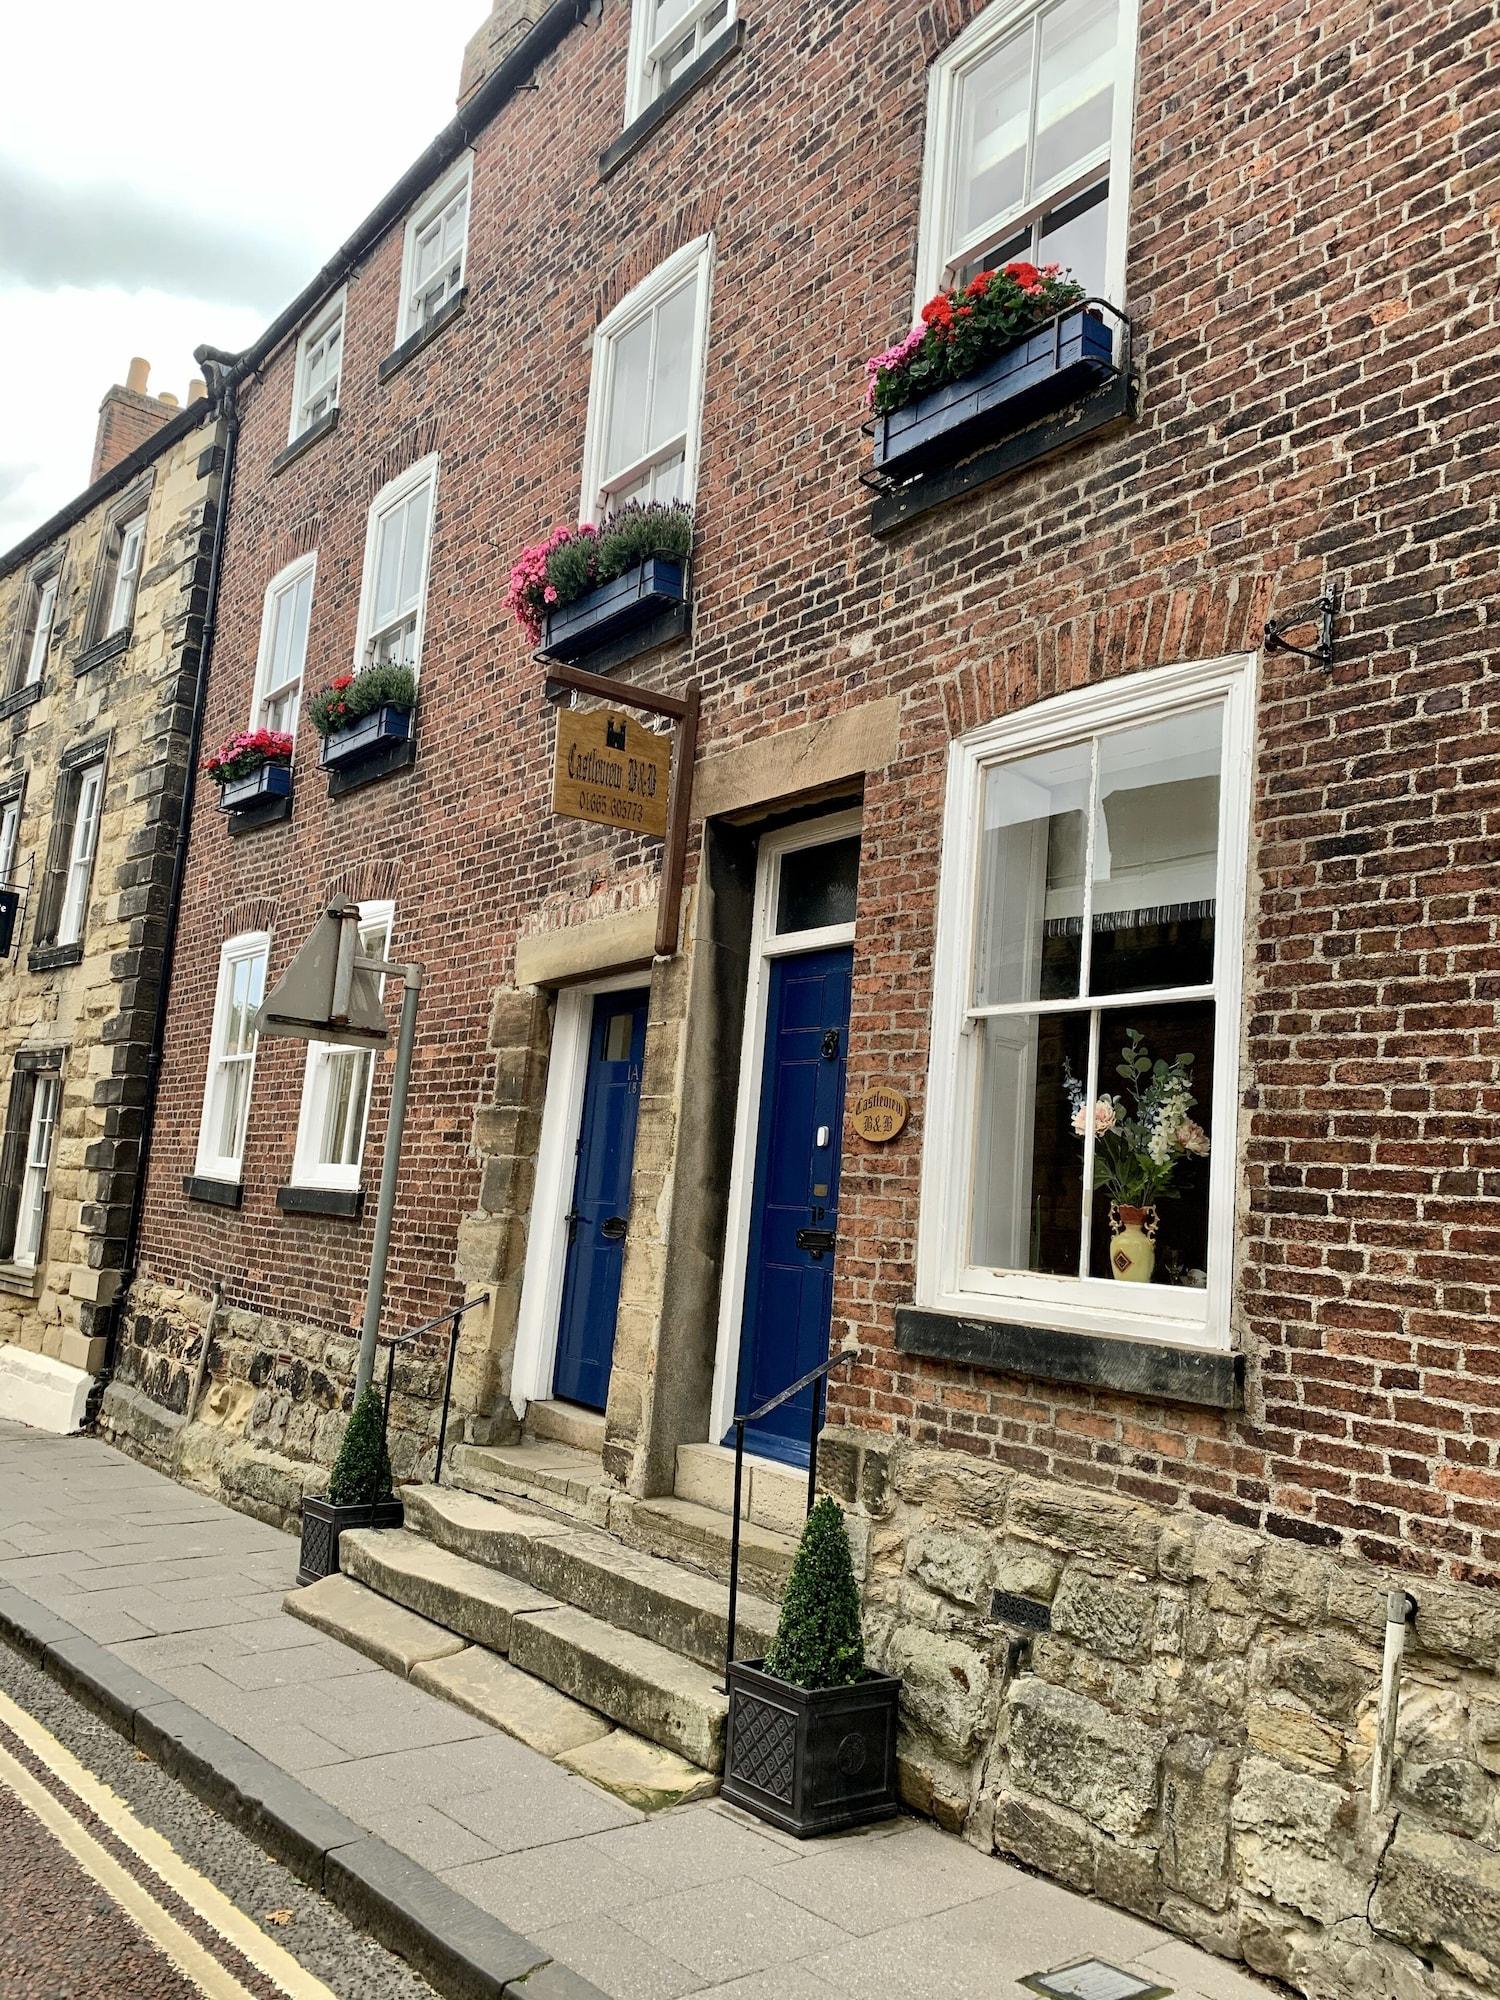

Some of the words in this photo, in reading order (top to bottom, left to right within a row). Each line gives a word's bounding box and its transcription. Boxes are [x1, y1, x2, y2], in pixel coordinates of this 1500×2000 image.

[568, 743, 623, 789] Castleview
[628, 758, 657, 798] B&B
[579, 791, 606, 816] 01665
[610, 798, 643, 823] 605773
[856, 1091, 903, 1117] Castleview
[863, 1114, 893, 1134] B&B
